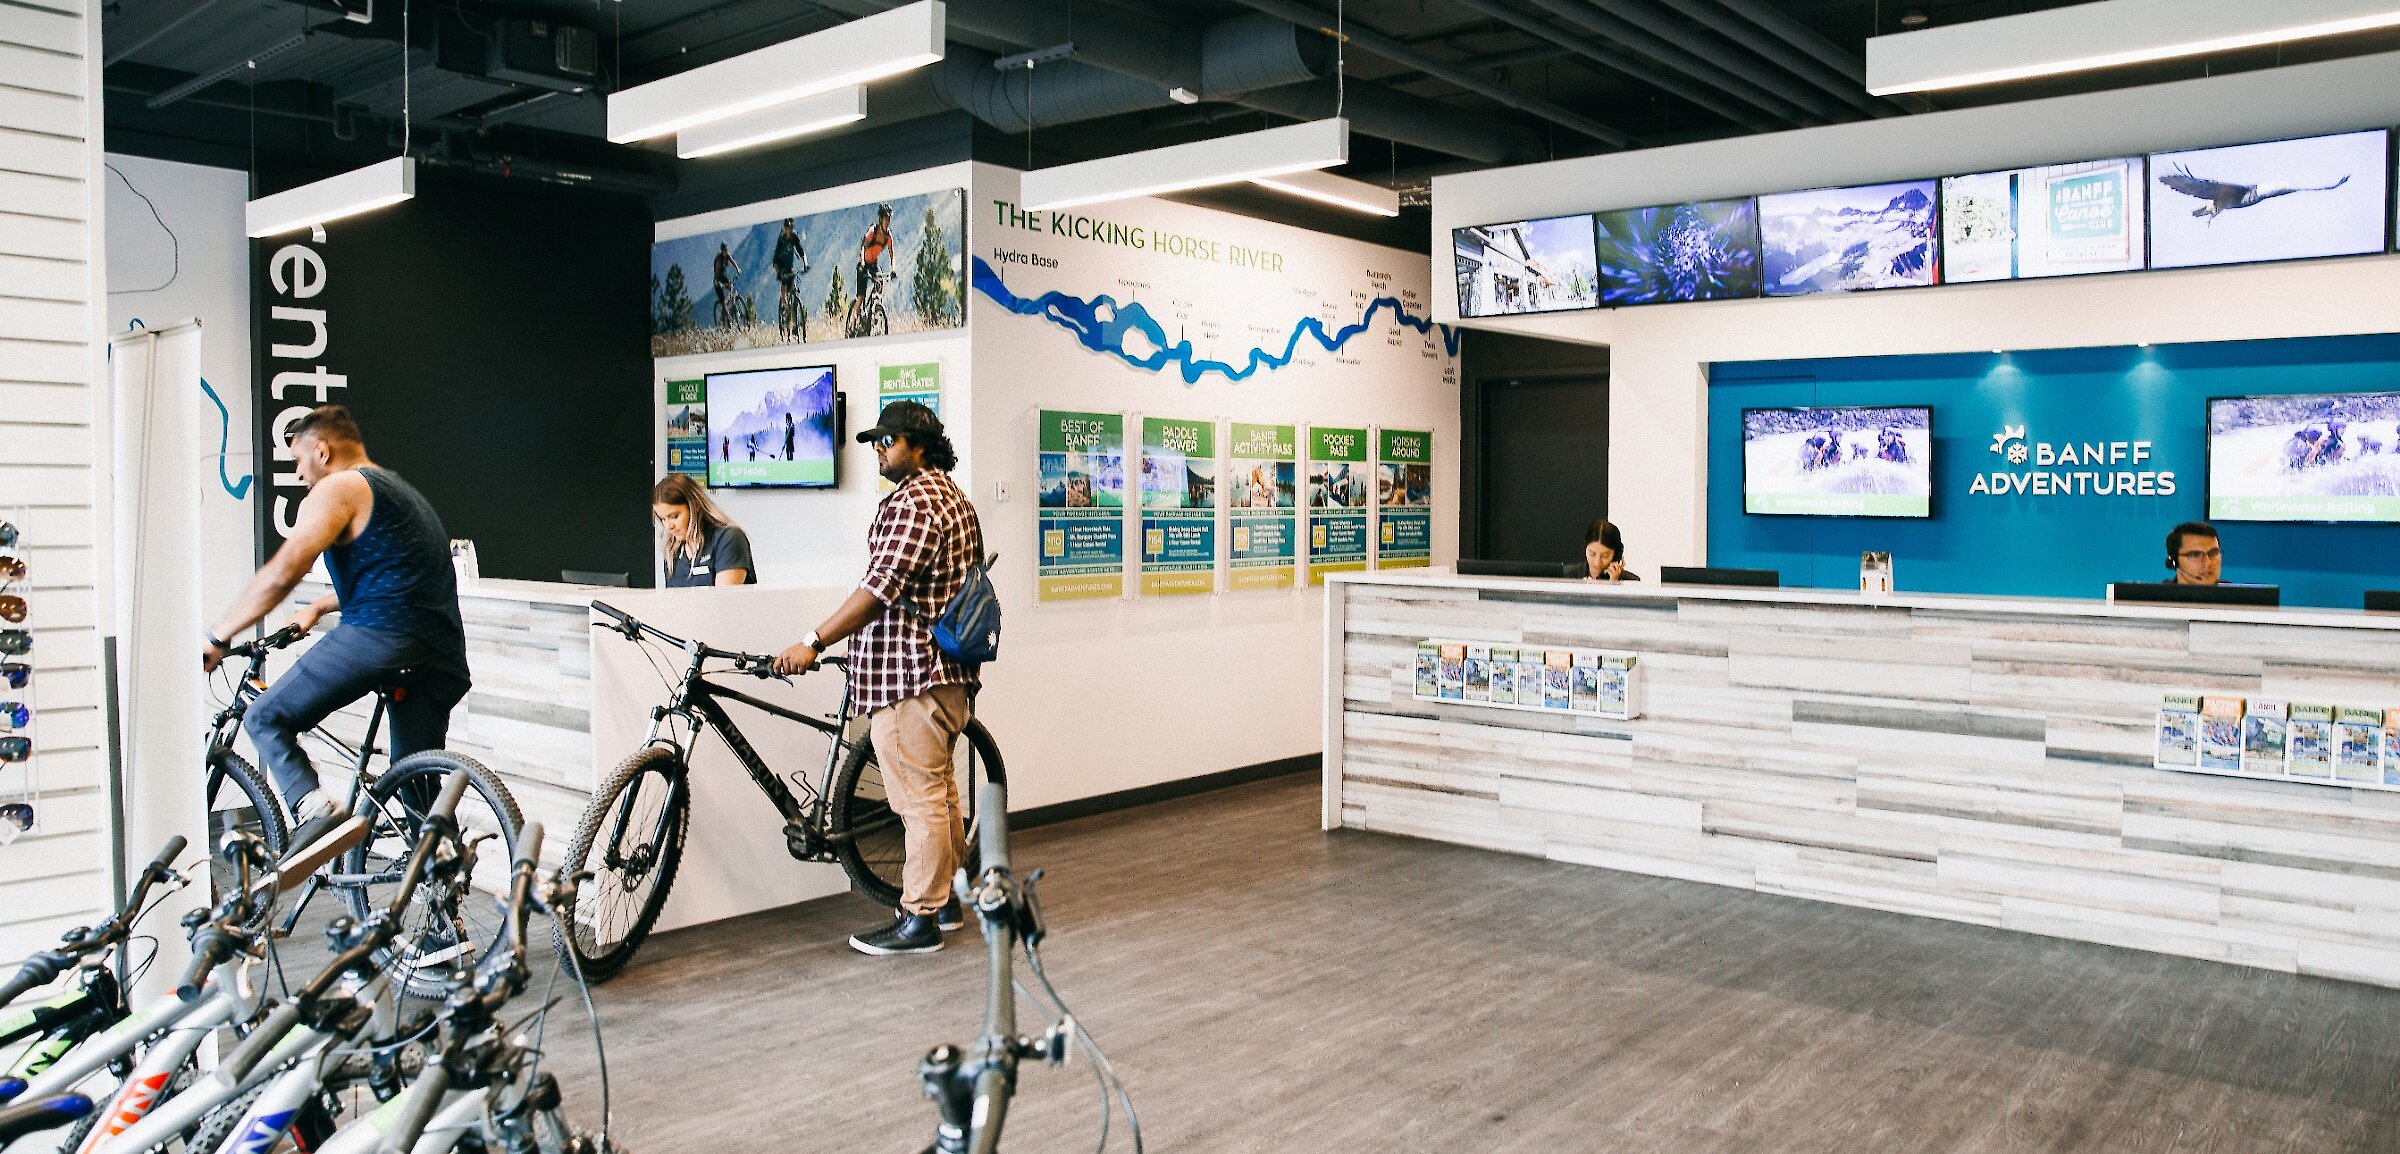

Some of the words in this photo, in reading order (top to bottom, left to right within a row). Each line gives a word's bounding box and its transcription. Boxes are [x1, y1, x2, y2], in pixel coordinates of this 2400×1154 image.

[994, 200, 1042, 233] THE
[1052, 211, 1145, 249] KICKING
[1154, 230, 1222, 263] HORSE
[1230, 245, 1283, 273] RIVER
[993, 247, 1028, 264] Hydra
[1031, 253, 1059, 268] Base
[1060, 419, 1088, 433] BEST
[1089, 420, 1105, 433] OF
[1162, 426, 1198, 440] PADDLE
[1065, 433, 1101, 447] BANFF
[1250, 430, 1277, 442] BANFF
[1323, 433, 1355, 446] ROCKIES
[1391, 436, 1421, 448] HORSING
[1162, 438, 1198, 452] POWER
[1233, 442, 1272, 455] ACTIVITY
[1272, 443, 1293, 455] PASS
[1329, 445, 1348, 457] PASS
[1391, 447, 1420, 458] AROUND
[2036, 441, 2152, 466] BANFF
[1968, 471, 2176, 496] ADVENTURES
[2251, 501, 2322, 512] Whitewater
[2327, 502, 2375, 515] Rafting
